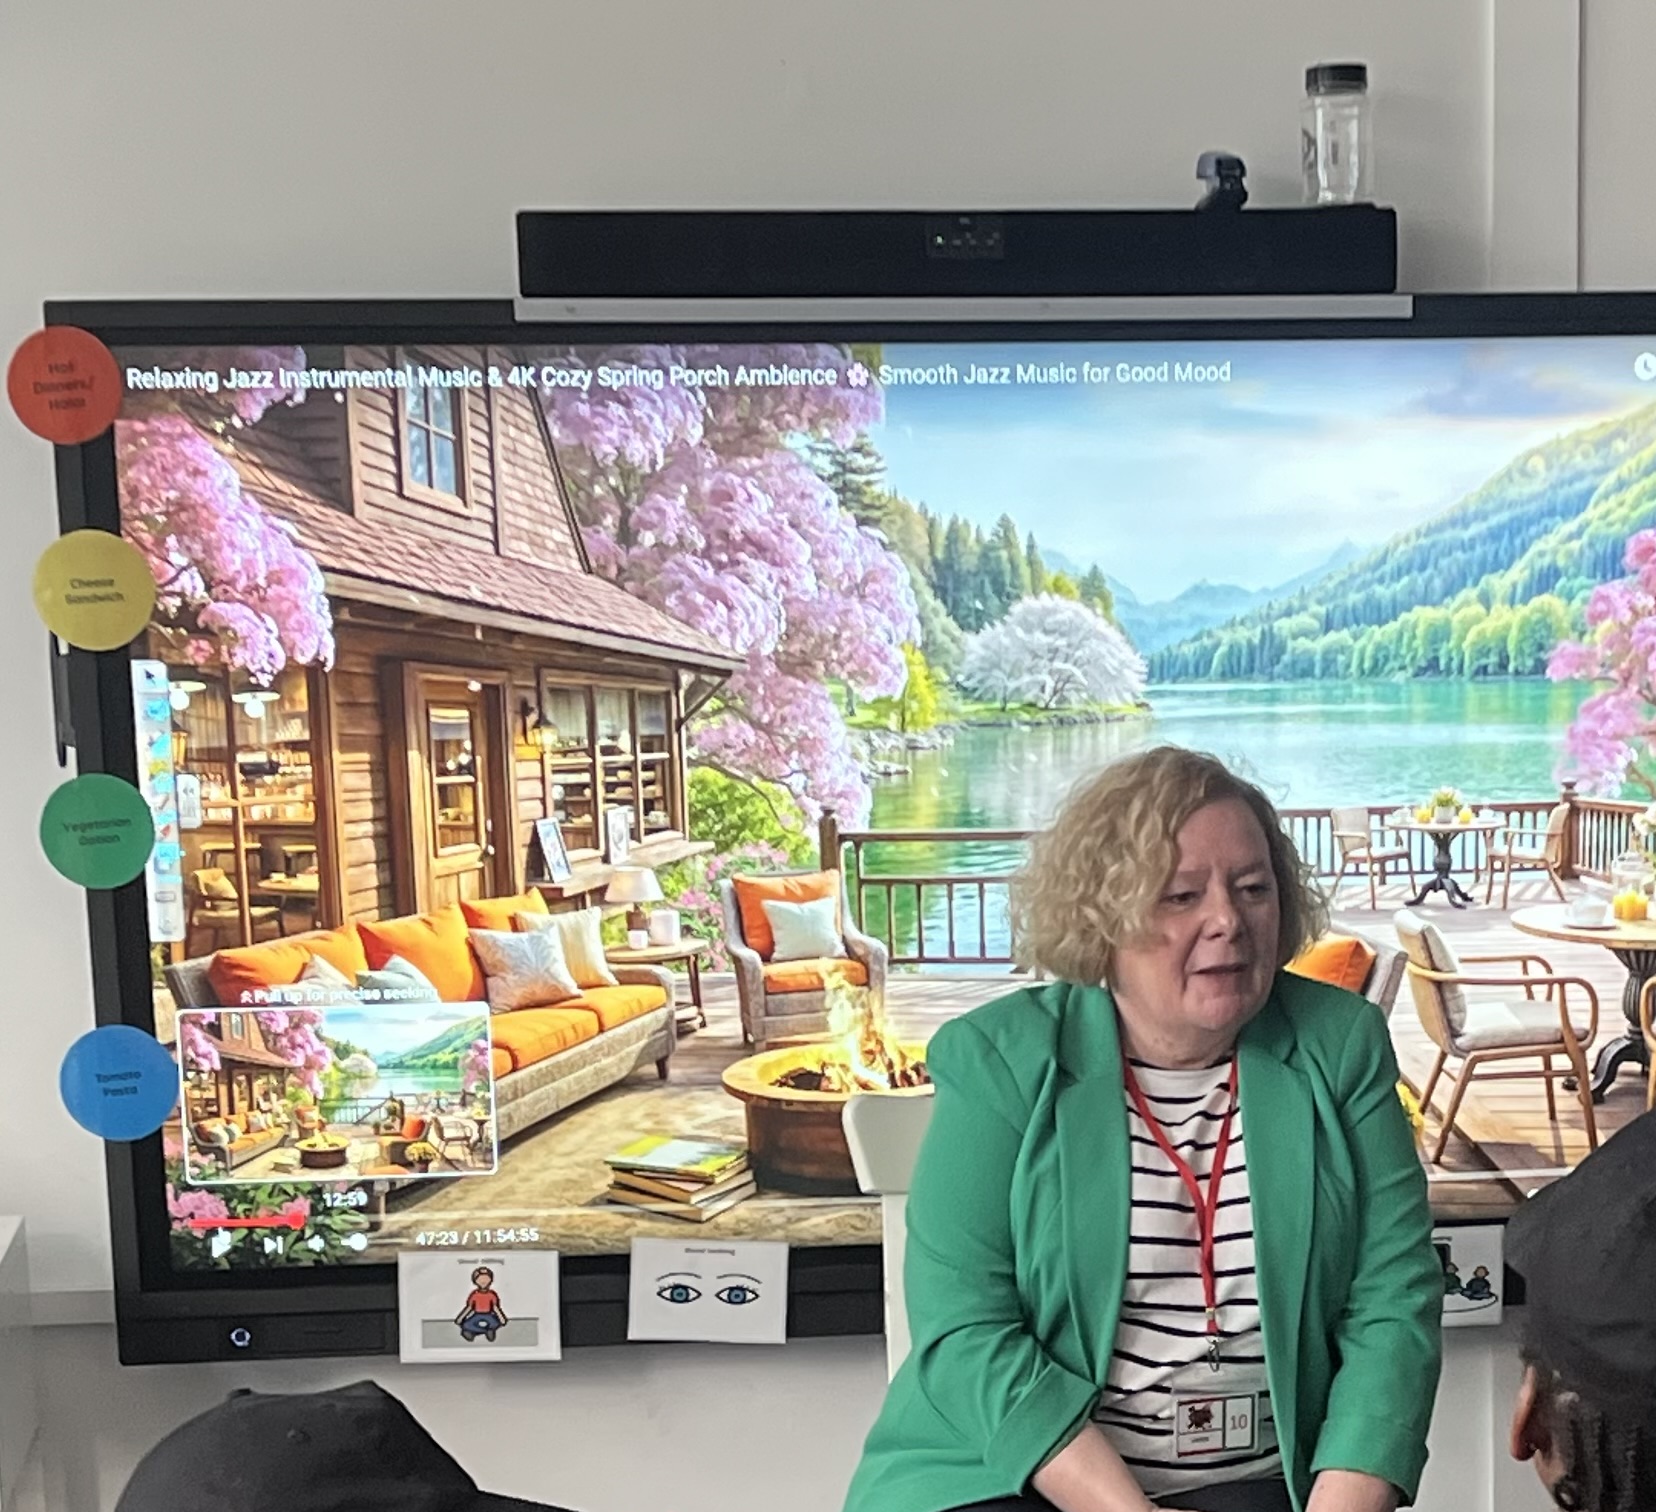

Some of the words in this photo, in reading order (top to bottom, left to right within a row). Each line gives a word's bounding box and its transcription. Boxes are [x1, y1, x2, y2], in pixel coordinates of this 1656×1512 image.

[126, 366, 219, 393] Relaxing
[222, 367, 275, 389] Jazz
[279, 363, 413, 389] Instrumental
[417, 365, 482, 388] Music
[487, 366, 503, 388] &
[506, 365, 538, 388] 4K
[540, 365, 593, 392] Cozy
[597, 364, 664, 391] Spring
[669, 364, 730, 387] Porch
[733, 363, 838, 387] Ambience
[878, 363, 958, 386] Smooth
[963, 363, 1011, 385] Jazz
[1016, 362, 1078, 385] Music
[1082, 362, 1111, 384] for
[1115, 361, 1169, 384] Good
[1174, 361, 1232, 383] Mood
[1230, 1413, 1248, 1431] 10
